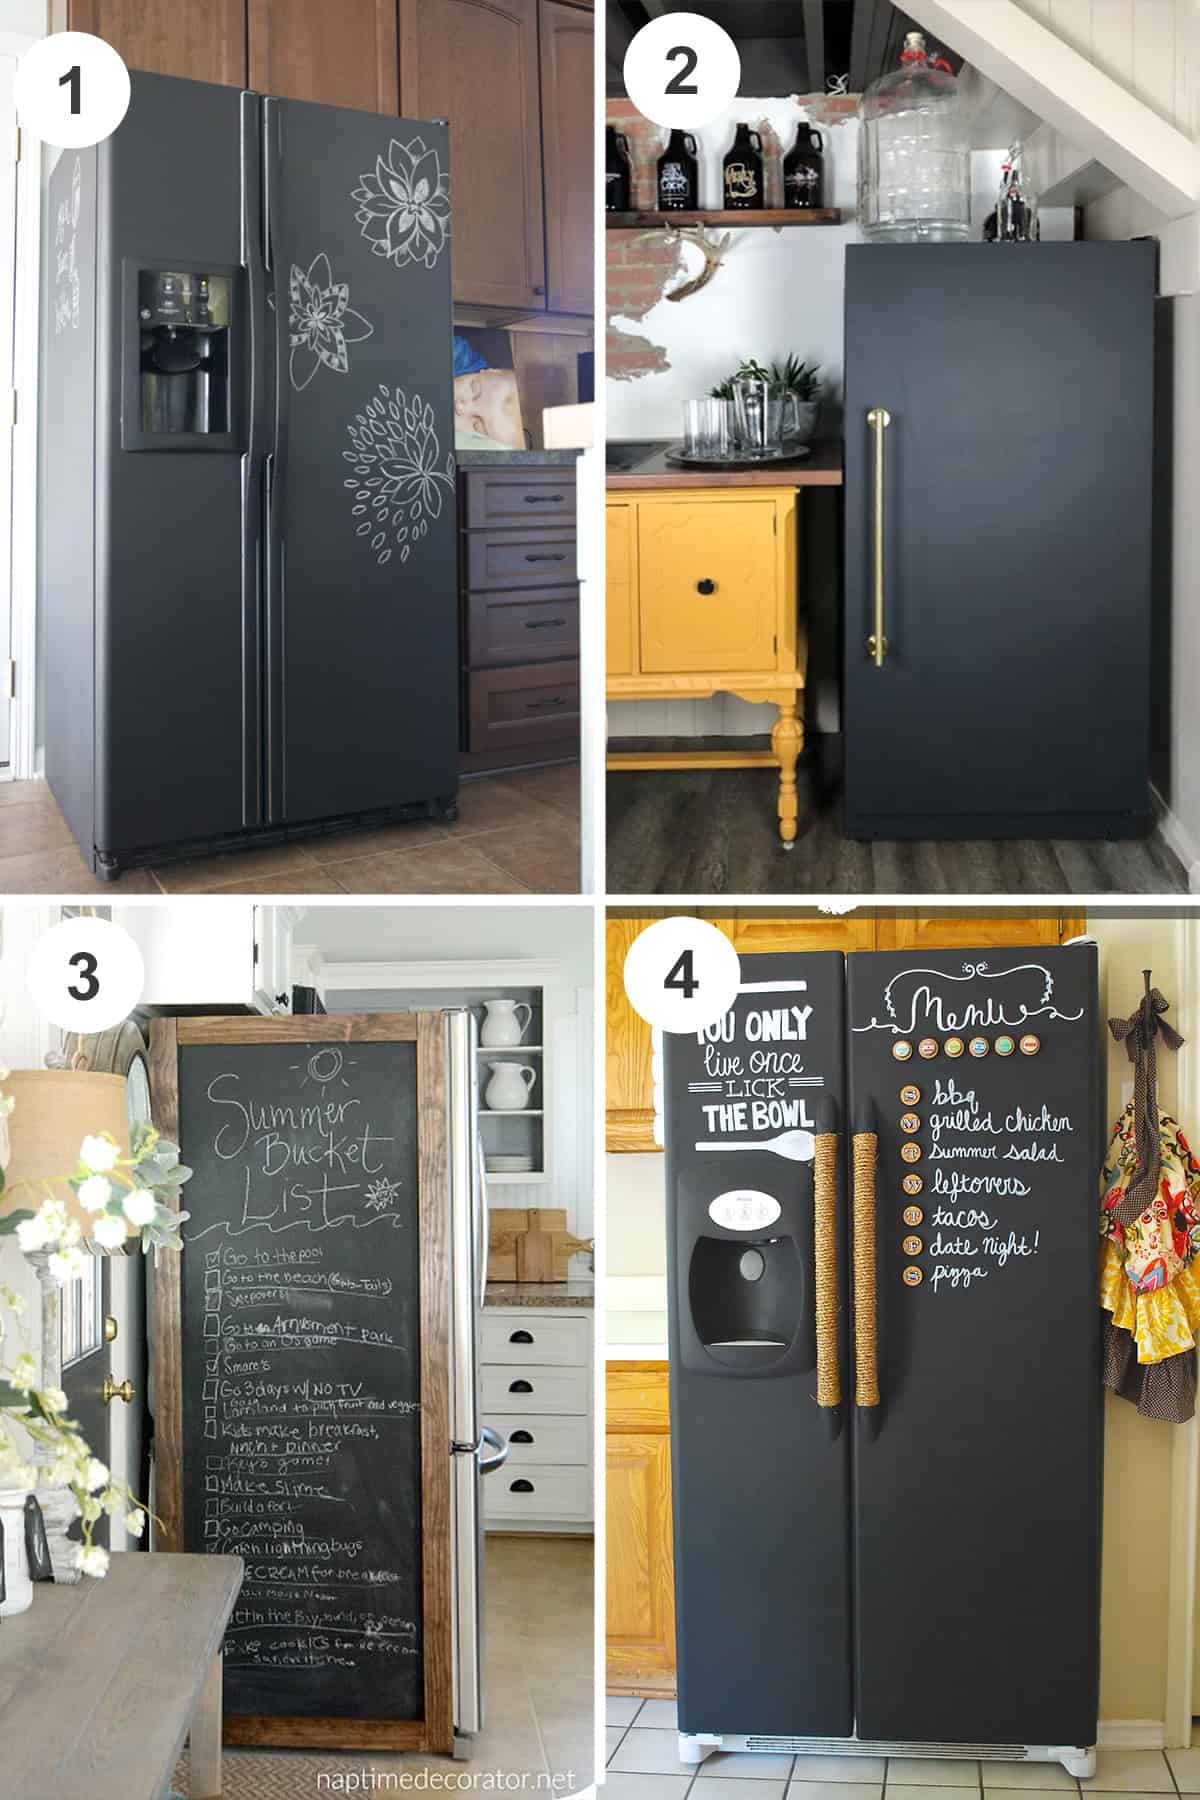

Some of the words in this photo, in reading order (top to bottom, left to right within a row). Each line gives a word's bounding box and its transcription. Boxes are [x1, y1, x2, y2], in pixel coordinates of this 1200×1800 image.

[745, 1005, 813, 1042] ONLY
[895, 986, 1030, 1033] Menu
[704, 1044, 744, 1077] live
[725, 1077, 785, 1098] LICK
[931, 1079, 980, 1113] bbq
[207, 1073, 360, 1160] Summer
[702, 1102, 748, 1132] THE
[752, 1099, 815, 1130] BOWL
[929, 1109, 1002, 1141] grilled
[1005, 1104, 1073, 1133] chicken
[255, 1123, 394, 1176] Bucket
[1003, 1141, 1065, 1162] salad
[242, 1166, 360, 1227] List
[930, 1167, 1031, 1203] leftovers
[931, 1205, 999, 1230] tacos
[223, 1248, 249, 1266] Go
[254, 1248, 270, 1265] to
[929, 1233, 979, 1257] date
[982, 1230, 1041, 1267] night!
[221, 1269, 238, 1286] Go
[239, 1272, 255, 1283] to
[930, 1263, 989, 1293] pizza
[220, 1380, 242, 1397] Go
[255, 1380, 290, 1399] days
[335, 1381, 363, 1397] TV
